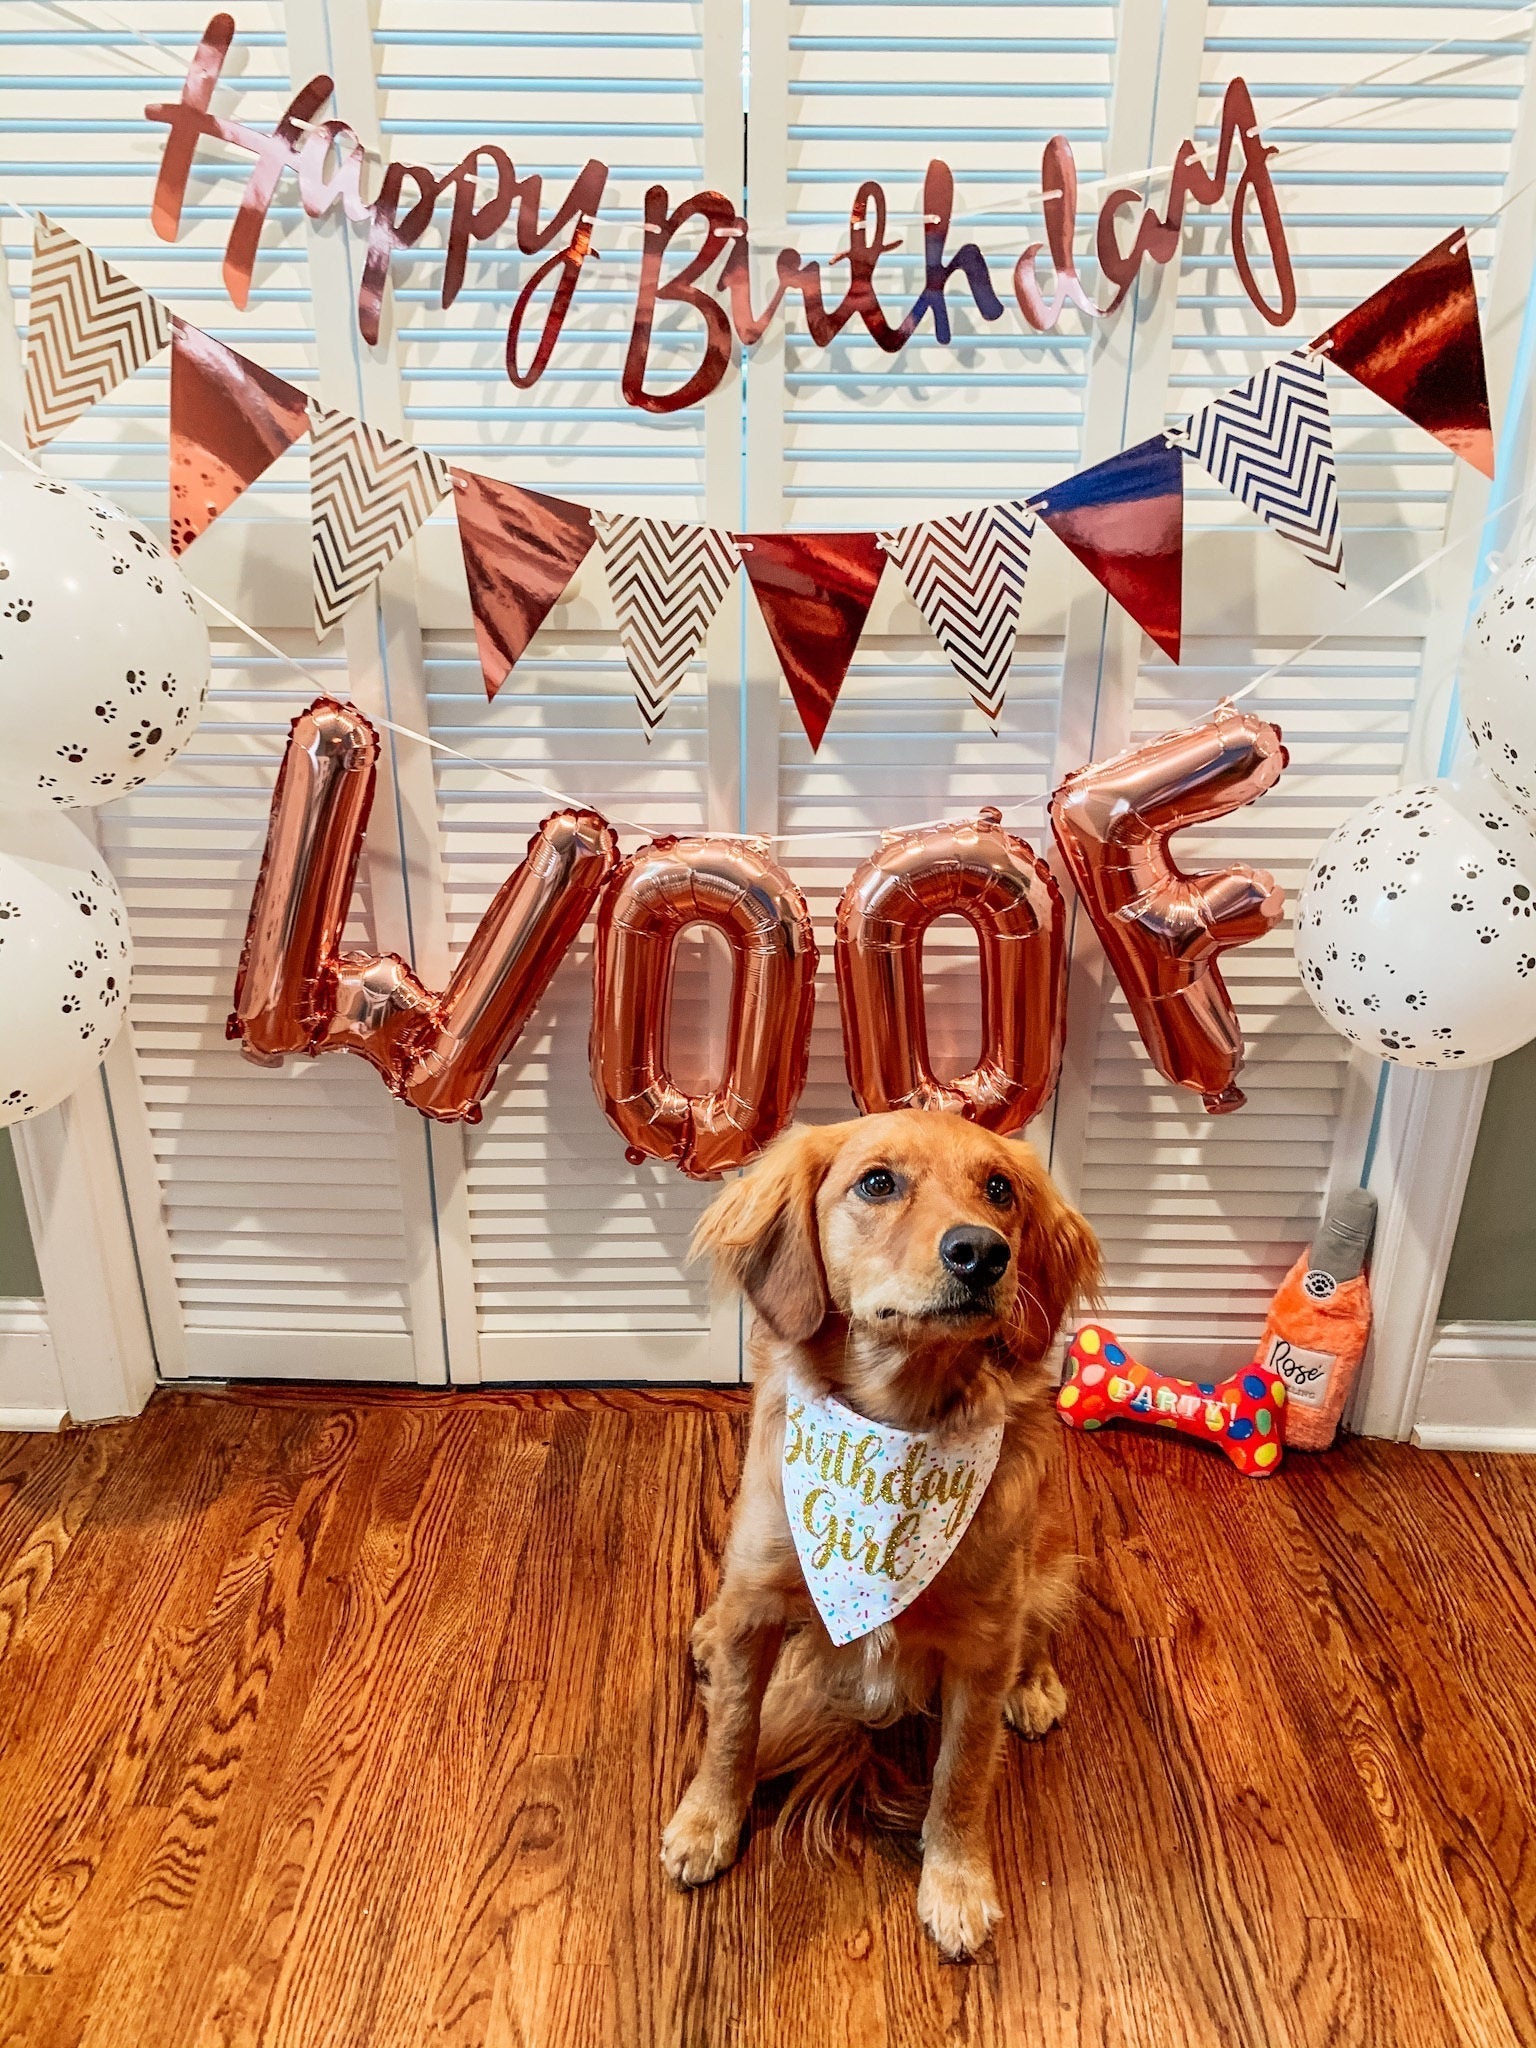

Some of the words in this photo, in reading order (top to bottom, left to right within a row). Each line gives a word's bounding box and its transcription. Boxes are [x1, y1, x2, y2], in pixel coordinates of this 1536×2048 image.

[145, 13, 610, 389] Happy
[622, 76, 1295, 412] Birthday
[227, 694, 1290, 1179] WOOF
[1111, 1376, 1237, 1428] PARTY!
[803, 1488, 921, 1582] Girl
